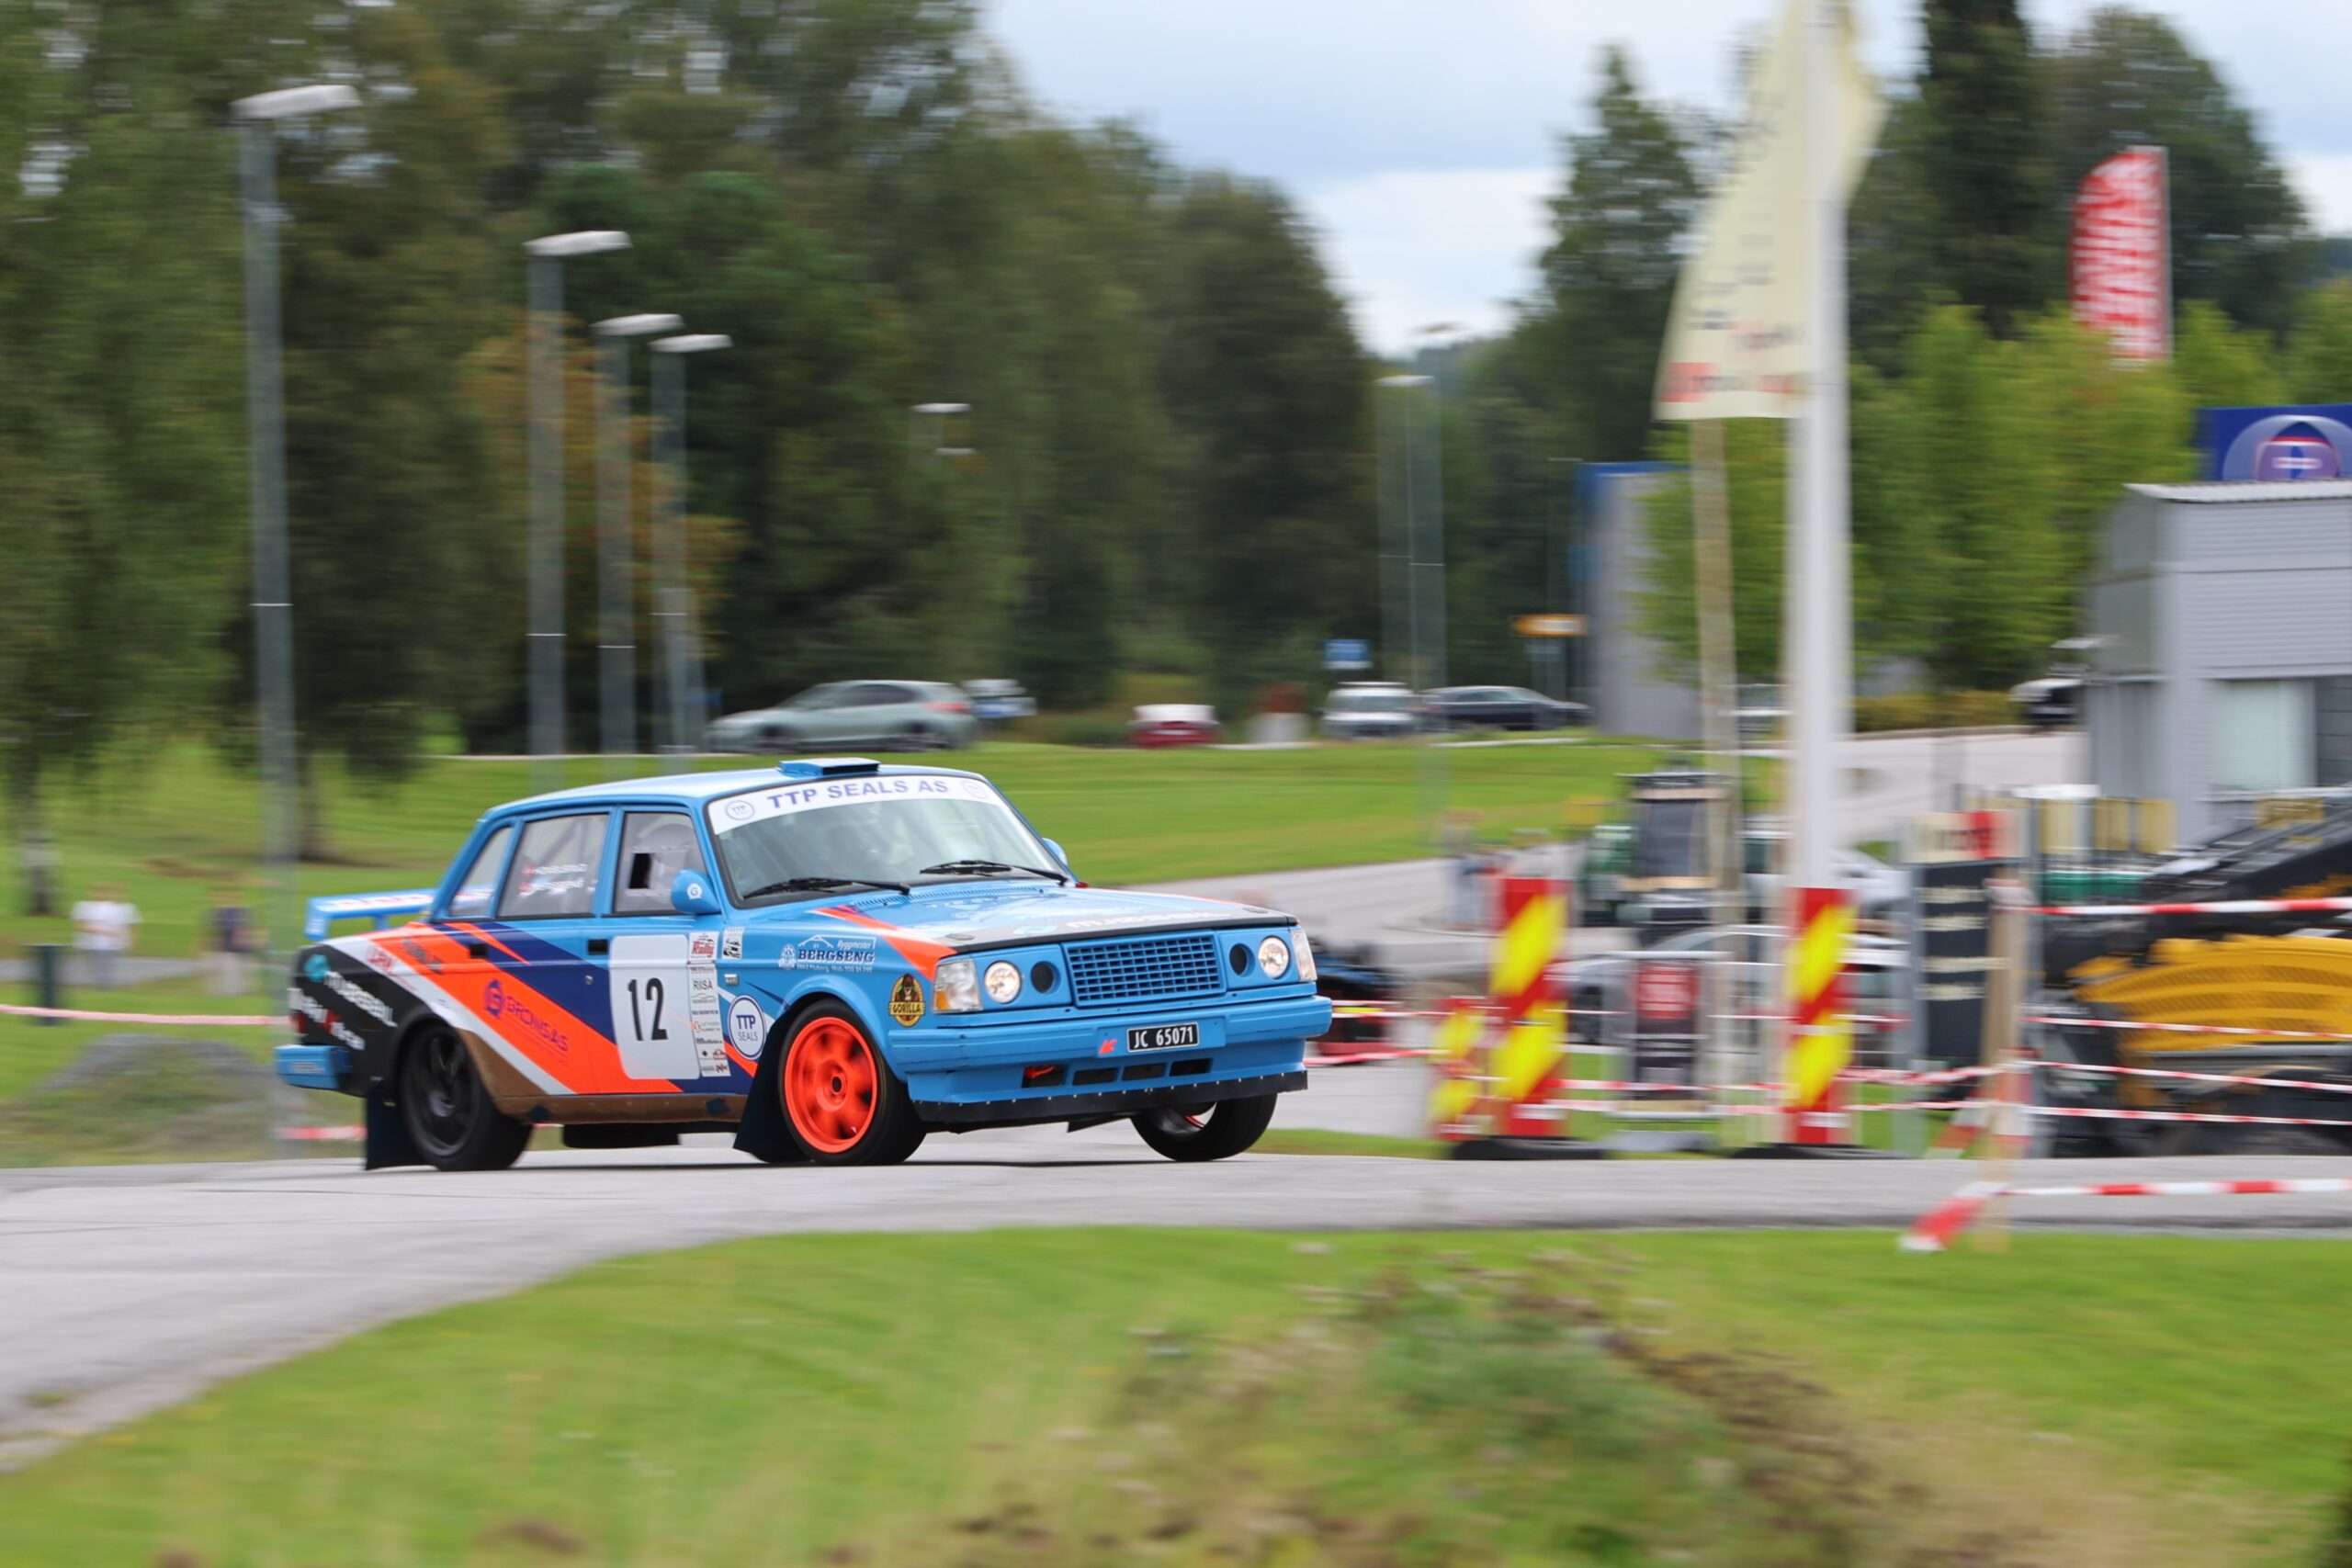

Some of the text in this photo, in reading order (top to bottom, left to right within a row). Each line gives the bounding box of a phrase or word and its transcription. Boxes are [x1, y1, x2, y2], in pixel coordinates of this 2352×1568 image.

[767, 780, 949, 808] TTP SEALS AS
[692, 941, 716, 958] Rally
[797, 948, 876, 964] BERGSENG
[628, 977, 669, 1042] 12
[892, 1003, 922, 1014] GORILLA
[736, 1014, 756, 1030] TTP
[738, 1031, 759, 1042] SEALS
[1134, 1025, 1194, 1049] JC 65071
